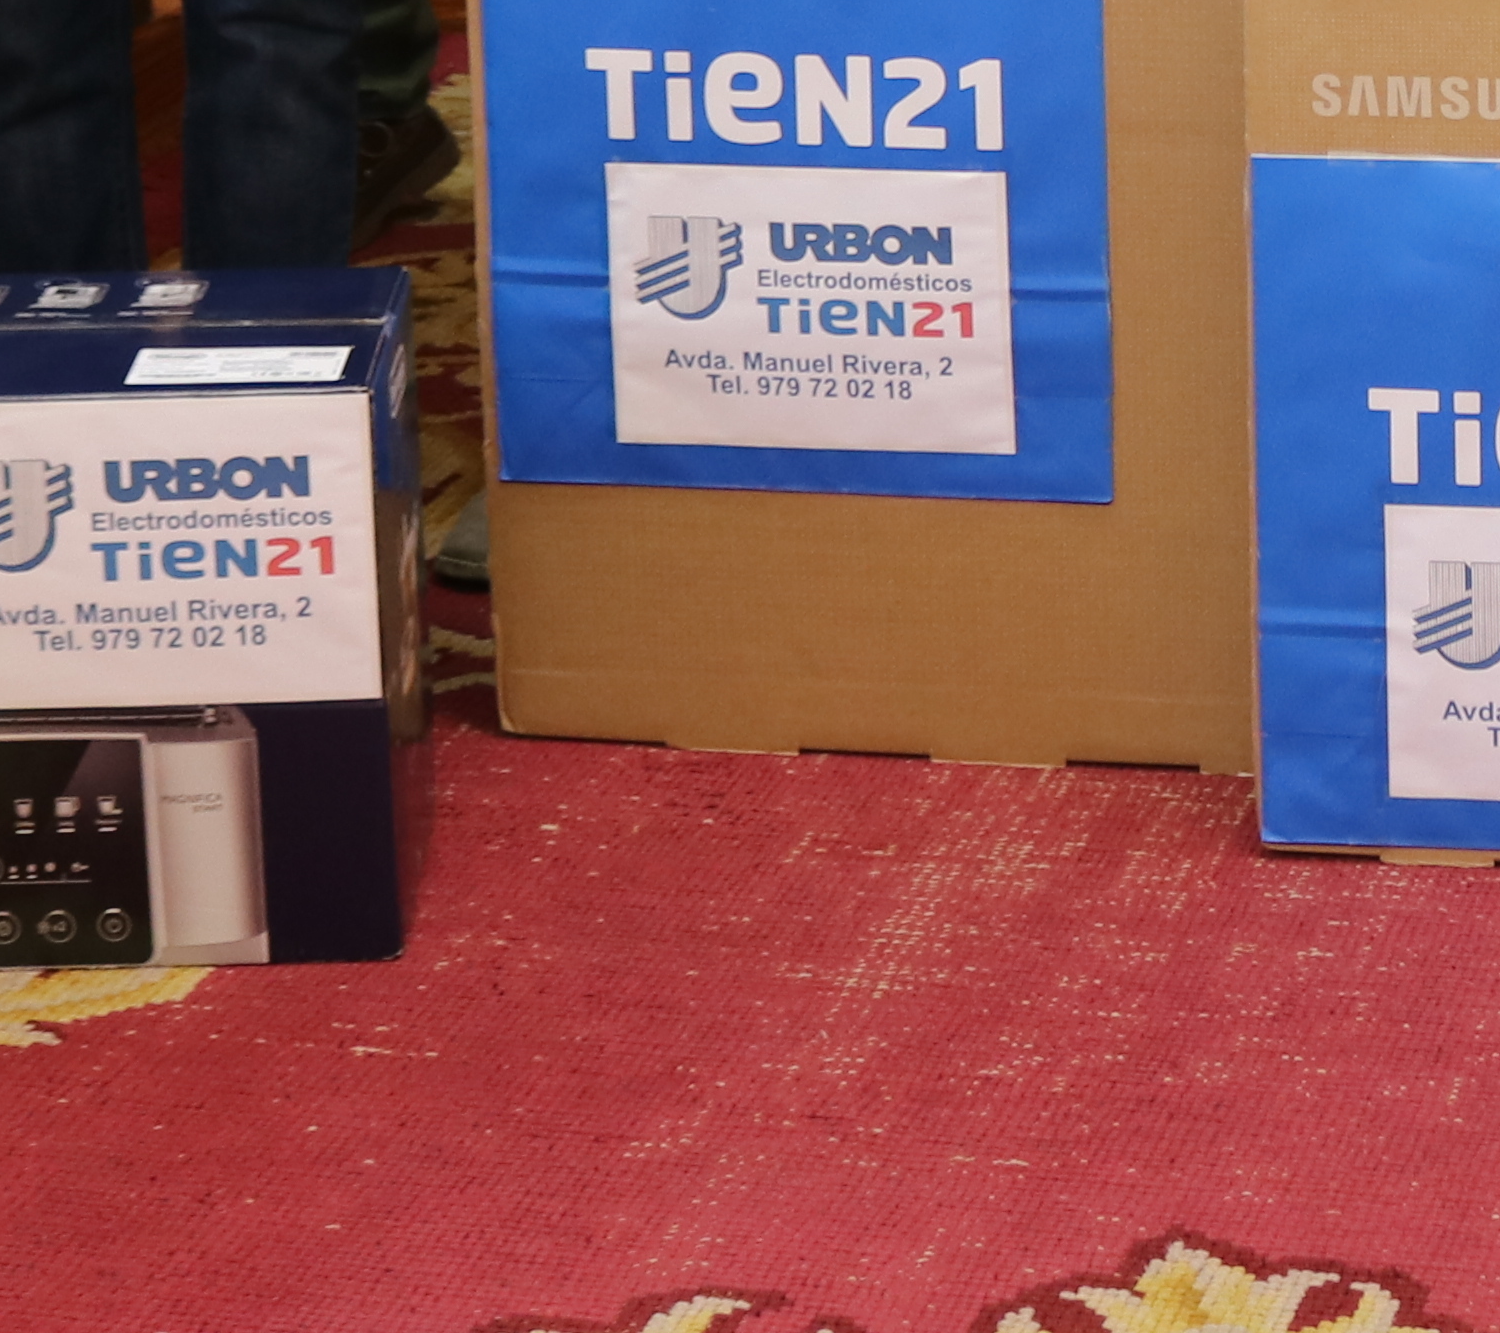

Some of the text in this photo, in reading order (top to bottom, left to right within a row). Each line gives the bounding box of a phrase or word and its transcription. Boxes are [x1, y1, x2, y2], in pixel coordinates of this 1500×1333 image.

[768, 222, 954, 265] URBON
[756, 269, 972, 293] Electrodomésticos
[664, 349, 954, 379] Avda. Manuel Rivera, 2
[706, 373, 913, 401] Tel. 979 72 02 18
[104, 455, 311, 503] URBON
[91, 507, 334, 533] Electrodomésticos
[76, 599, 177, 625] Manuel
[188, 598, 287, 623] Rivera,
[296, 596, 312, 618] 2
[34, 623, 268, 651] Tel. 979 72 02 18
